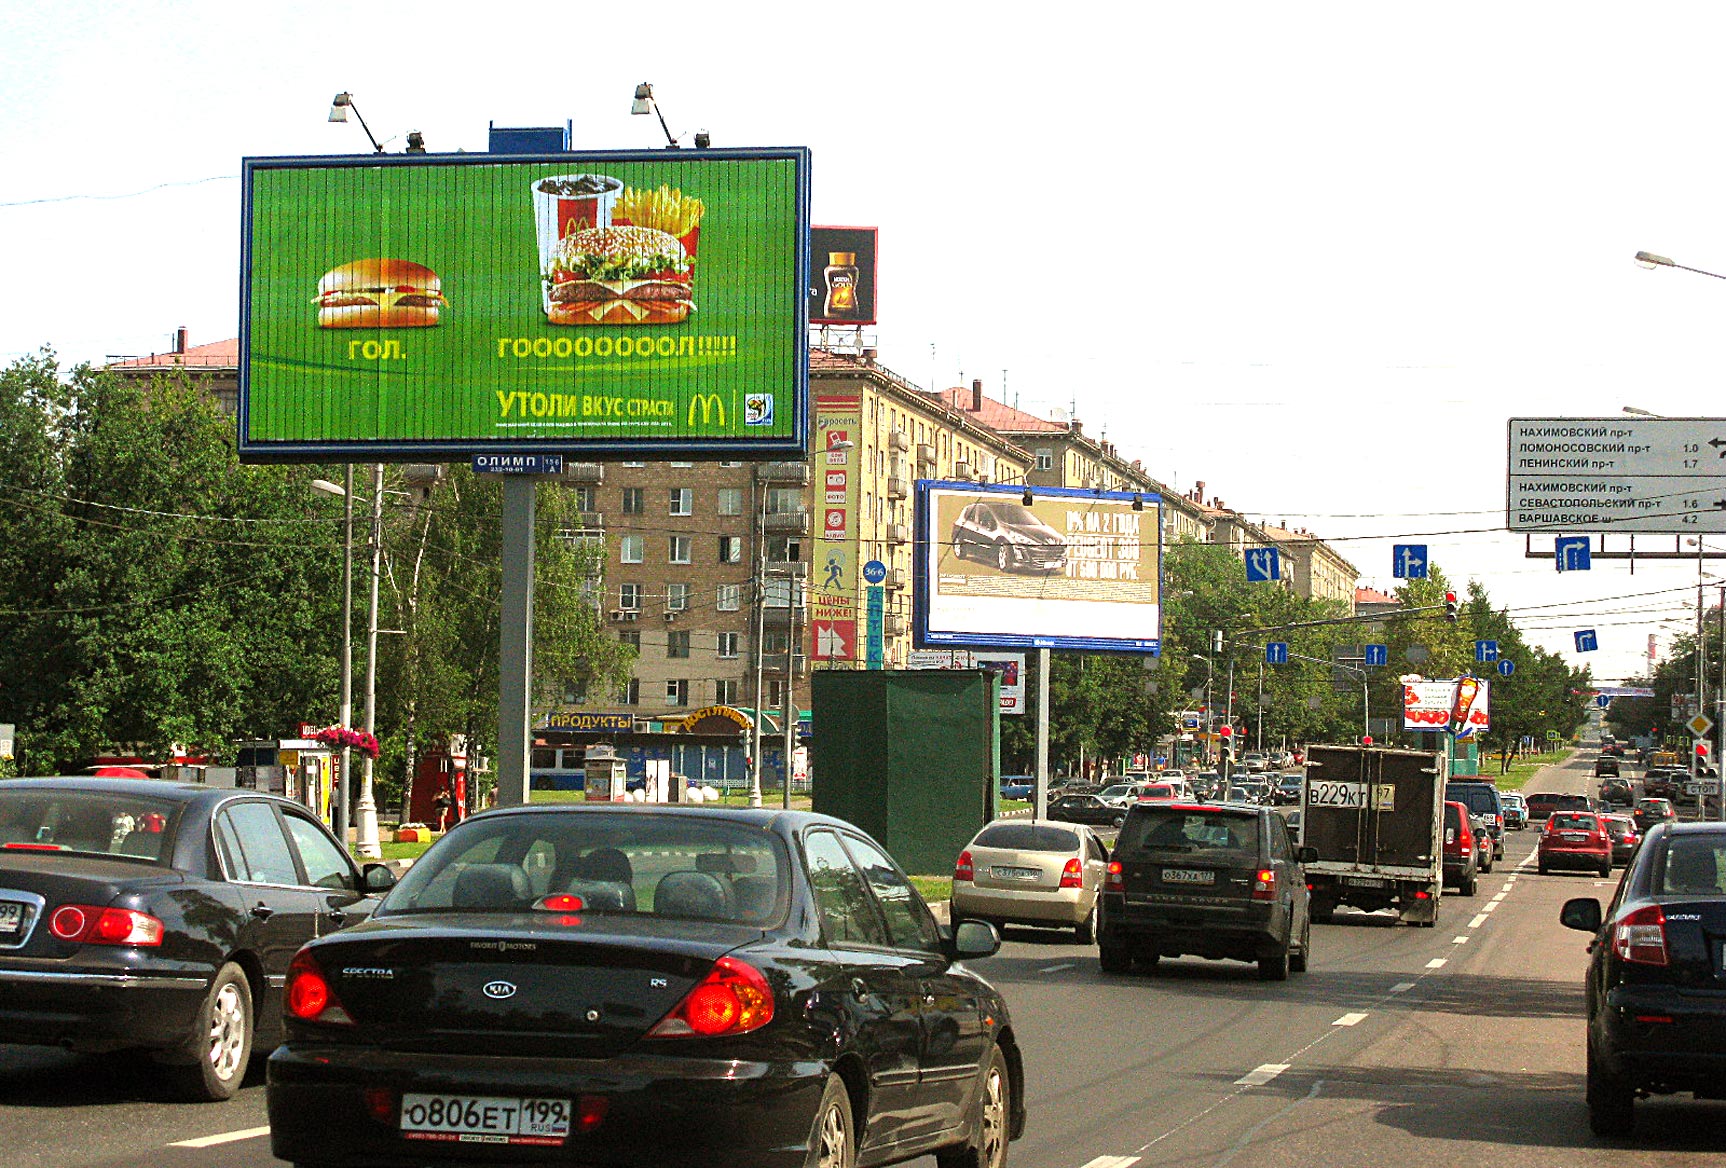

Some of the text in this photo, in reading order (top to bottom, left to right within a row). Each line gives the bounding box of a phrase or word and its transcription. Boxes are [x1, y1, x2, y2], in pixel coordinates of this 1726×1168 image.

[348, 340, 407, 360] ГОЛ.
[495, 390, 674, 418] УТОЛИ ВКУС СТРАСТИ
[1519, 427, 1633, 439] НАХИМОВСКИЙ пр-т
[1519, 442, 1699, 455] ЛОМОНОСОВСКИЙ пр-т 1.0
[477, 456, 536, 467] ОЛИМП
[1519, 458, 1698, 469] ЛЕНИНСКИЙ пр-т 1.7
[1519, 482, 1632, 494] НАХИМОВСКИЙ пр-т
[1519, 498, 1636, 508] СЕВАСТОПОЛЬСКИЙ
[1637, 500, 1662, 509] пр-т
[1519, 513, 1599, 523] ВАРШАВСКОЕ
[1681, 515, 1698, 524] 4.2
[818, 595, 850, 606] ЦЕНЫ
[815, 607, 852, 618] НИЖЕ!
[551, 715, 631, 729] ПРОДУКТЫ
[342, 967, 394, 975] SPECTRA
[650, 978, 667, 988] RS
[408, 1098, 565, 1130] О806ЕТ 199
[530, 1123, 552, 1133] RUS
